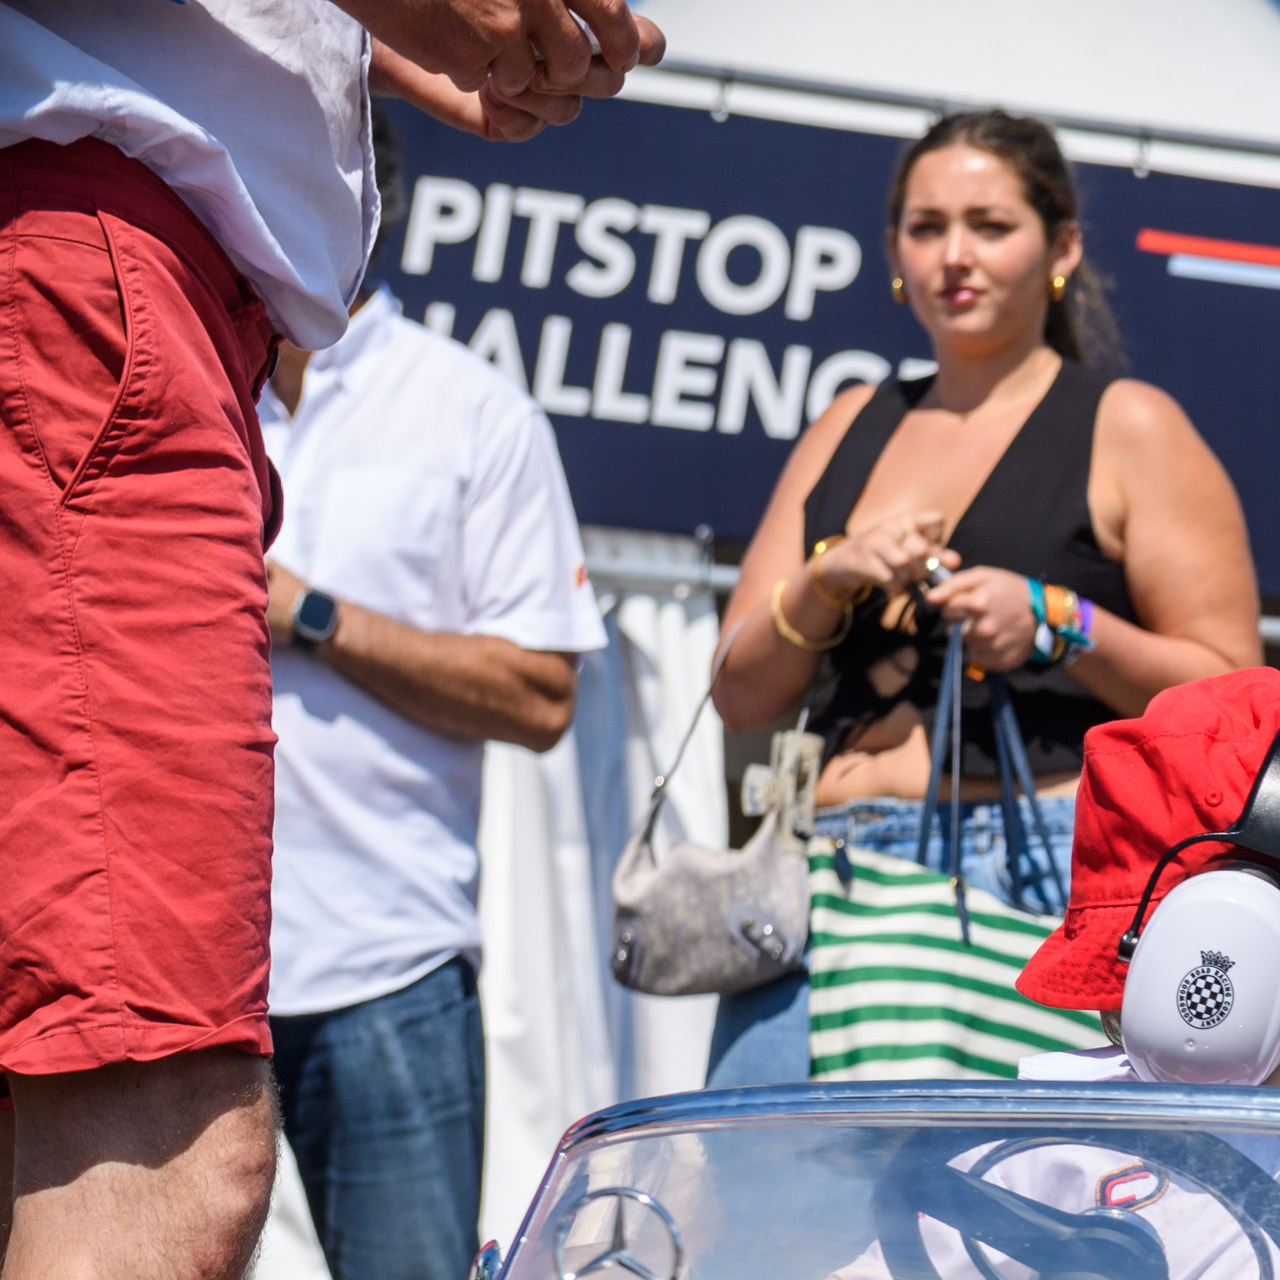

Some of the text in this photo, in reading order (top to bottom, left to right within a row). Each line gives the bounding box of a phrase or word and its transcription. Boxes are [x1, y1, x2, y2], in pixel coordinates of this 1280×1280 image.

[401, 174, 862, 321] PITSTOP
[1179, 968, 1231, 1027] GOODWOOD ROAD RACING COMPANY
